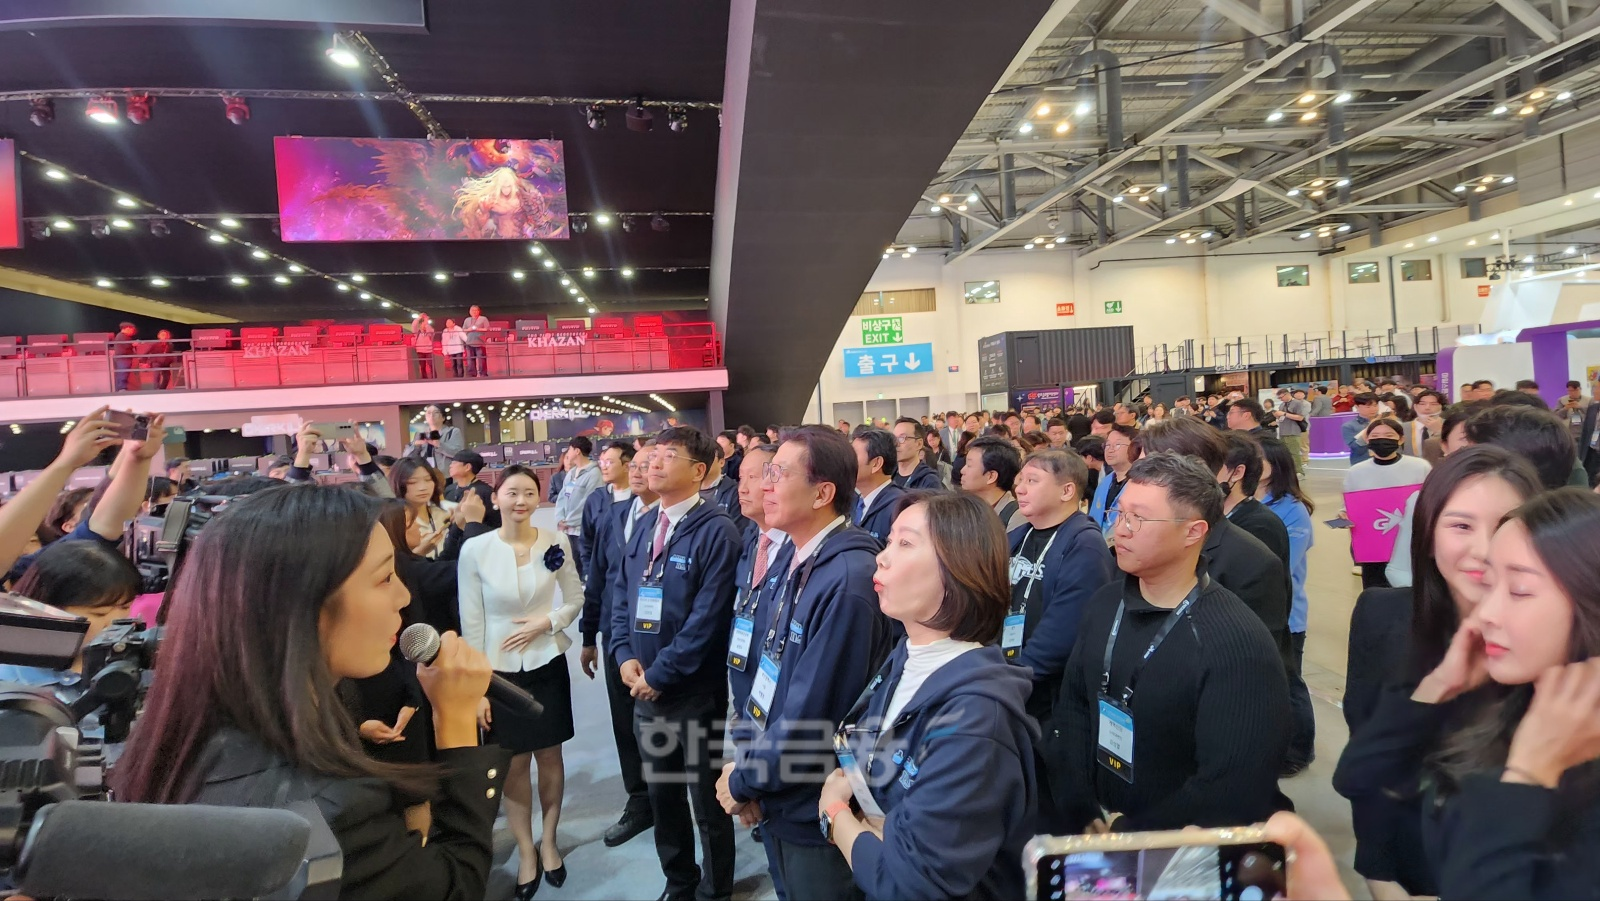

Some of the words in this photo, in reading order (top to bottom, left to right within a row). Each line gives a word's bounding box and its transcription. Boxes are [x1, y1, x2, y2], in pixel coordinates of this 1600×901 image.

[862, 319, 891, 332] 비상구
[528, 335, 586, 348] KHAZAN
[865, 333, 889, 344] EXIT
[243, 345, 310, 358] KHAZAN
[733, 657, 741, 665] VIP
[753, 706, 761, 717] VIP
[1109, 757, 1121, 769] VIP
